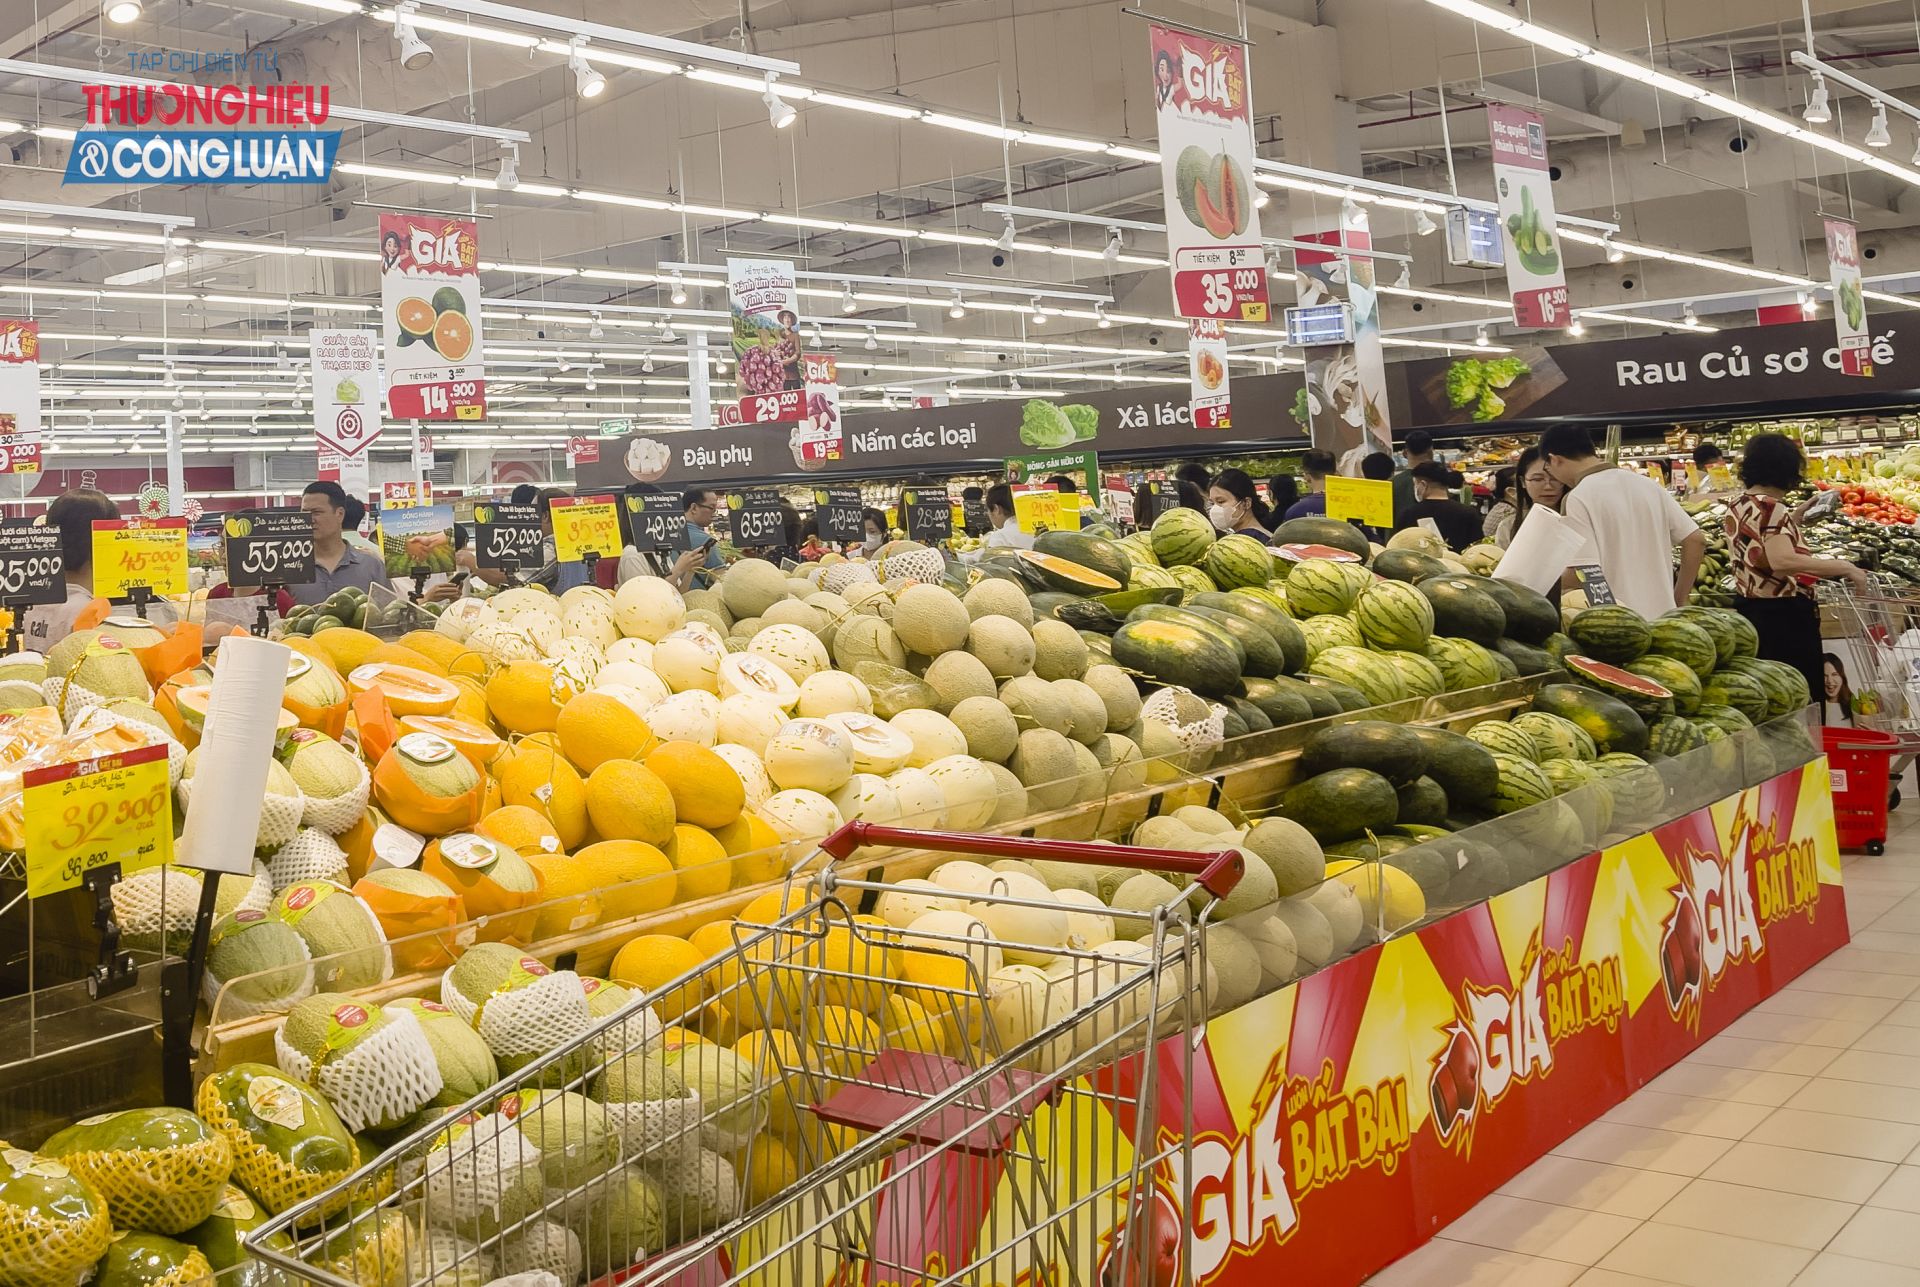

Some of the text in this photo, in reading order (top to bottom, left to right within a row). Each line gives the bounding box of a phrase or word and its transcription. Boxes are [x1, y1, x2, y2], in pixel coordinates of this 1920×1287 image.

[1616, 360, 1687, 386] Rau
[1700, 345, 1750, 379] Củ
[1764, 346, 1808, 374] sơ
[1117, 404, 1149, 429] Xà
[851, 423, 977, 453] Nấm các loại
[682, 444, 752, 467] Đậu phụ
[242, 540, 313, 573] 55.000
[487, 527, 543, 558] 52.000
[1686, 815, 1764, 978] GIÁ
[1465, 944, 1553, 1104] GIÁ
[1160, 1062, 1409, 1278] GIÁ LUÔN BẤT BẠI
